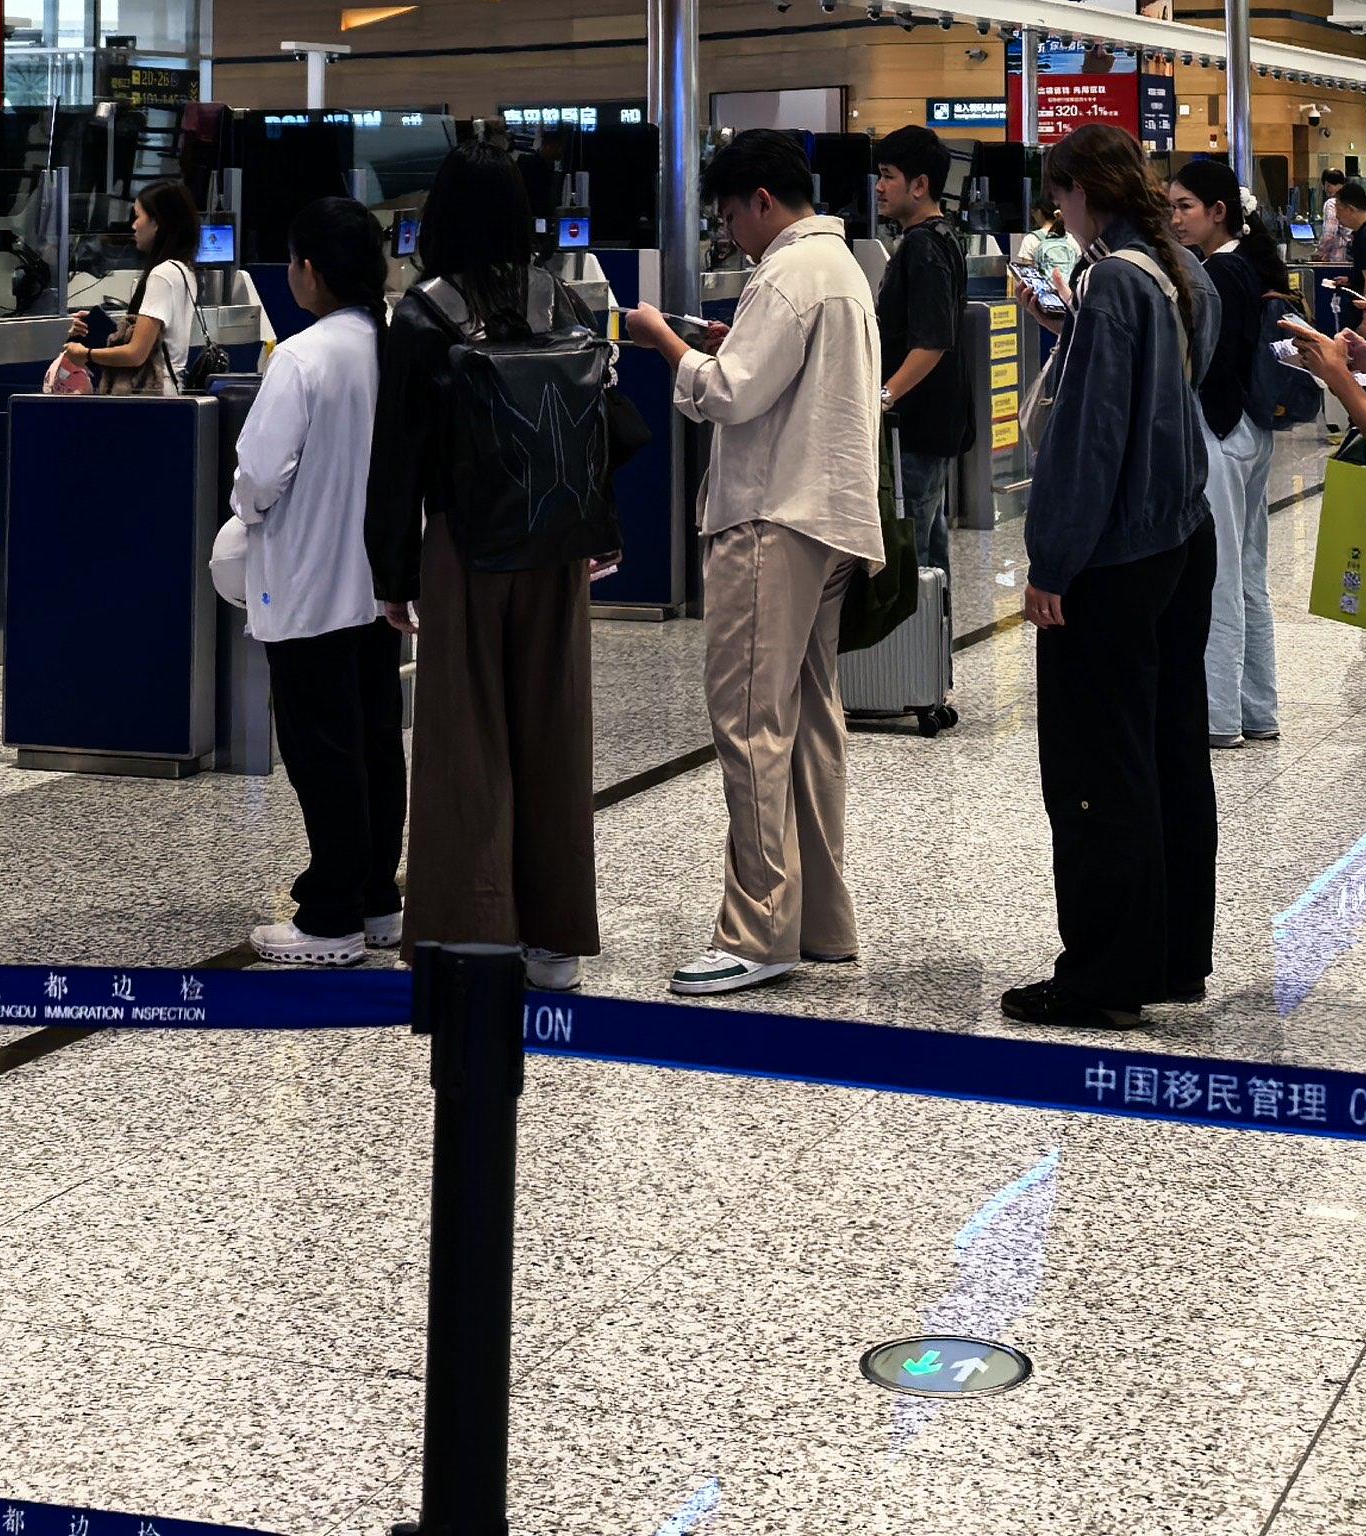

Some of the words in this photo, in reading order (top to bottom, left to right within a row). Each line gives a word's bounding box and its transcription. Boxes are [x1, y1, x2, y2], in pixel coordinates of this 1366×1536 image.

[1055, 105, 1078, 116] 320
[44, 1005, 124, 1020] IMMIGRATION
[131, 1007, 206, 1021] INSPECTION
[1084, 1061, 1327, 1123] 中国移民管理
